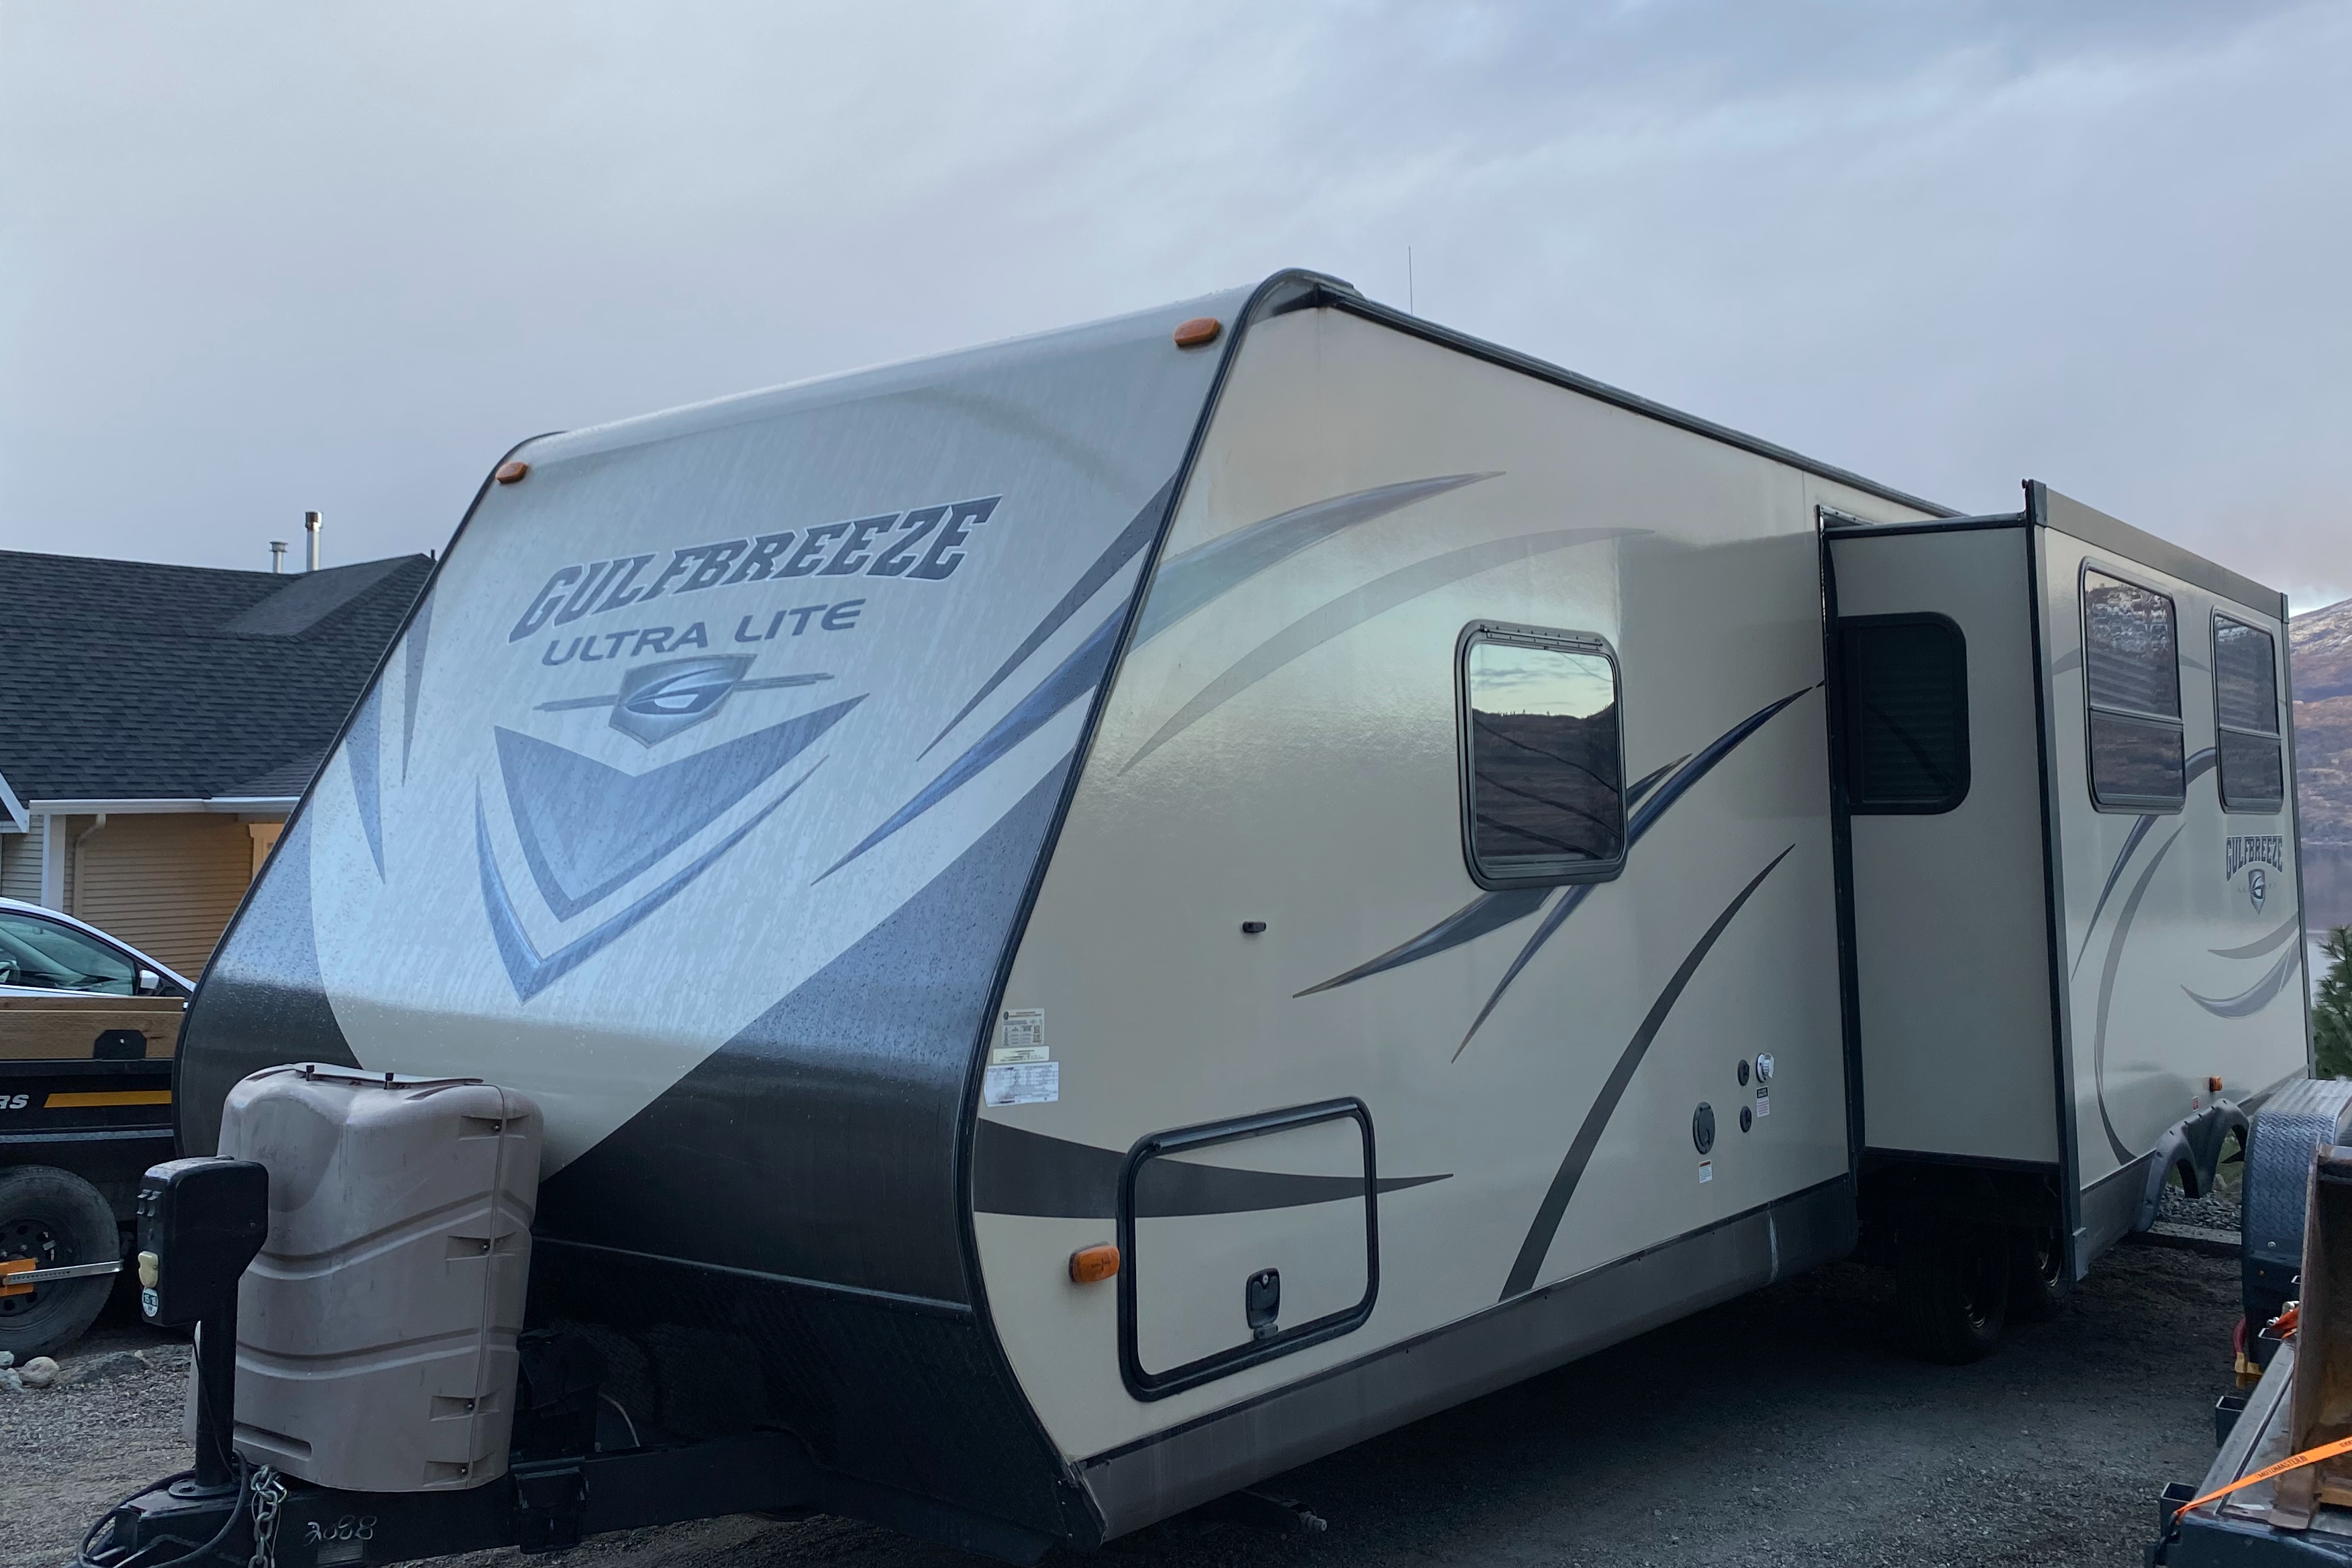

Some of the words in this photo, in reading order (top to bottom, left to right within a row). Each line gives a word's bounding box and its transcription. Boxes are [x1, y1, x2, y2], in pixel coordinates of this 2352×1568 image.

[508, 494, 1003, 643] GULFBREEZE
[541, 621, 709, 666] ULTRA
[733, 598, 866, 643] LITE
[2226, 835, 2283, 881] GULFBREEZE
